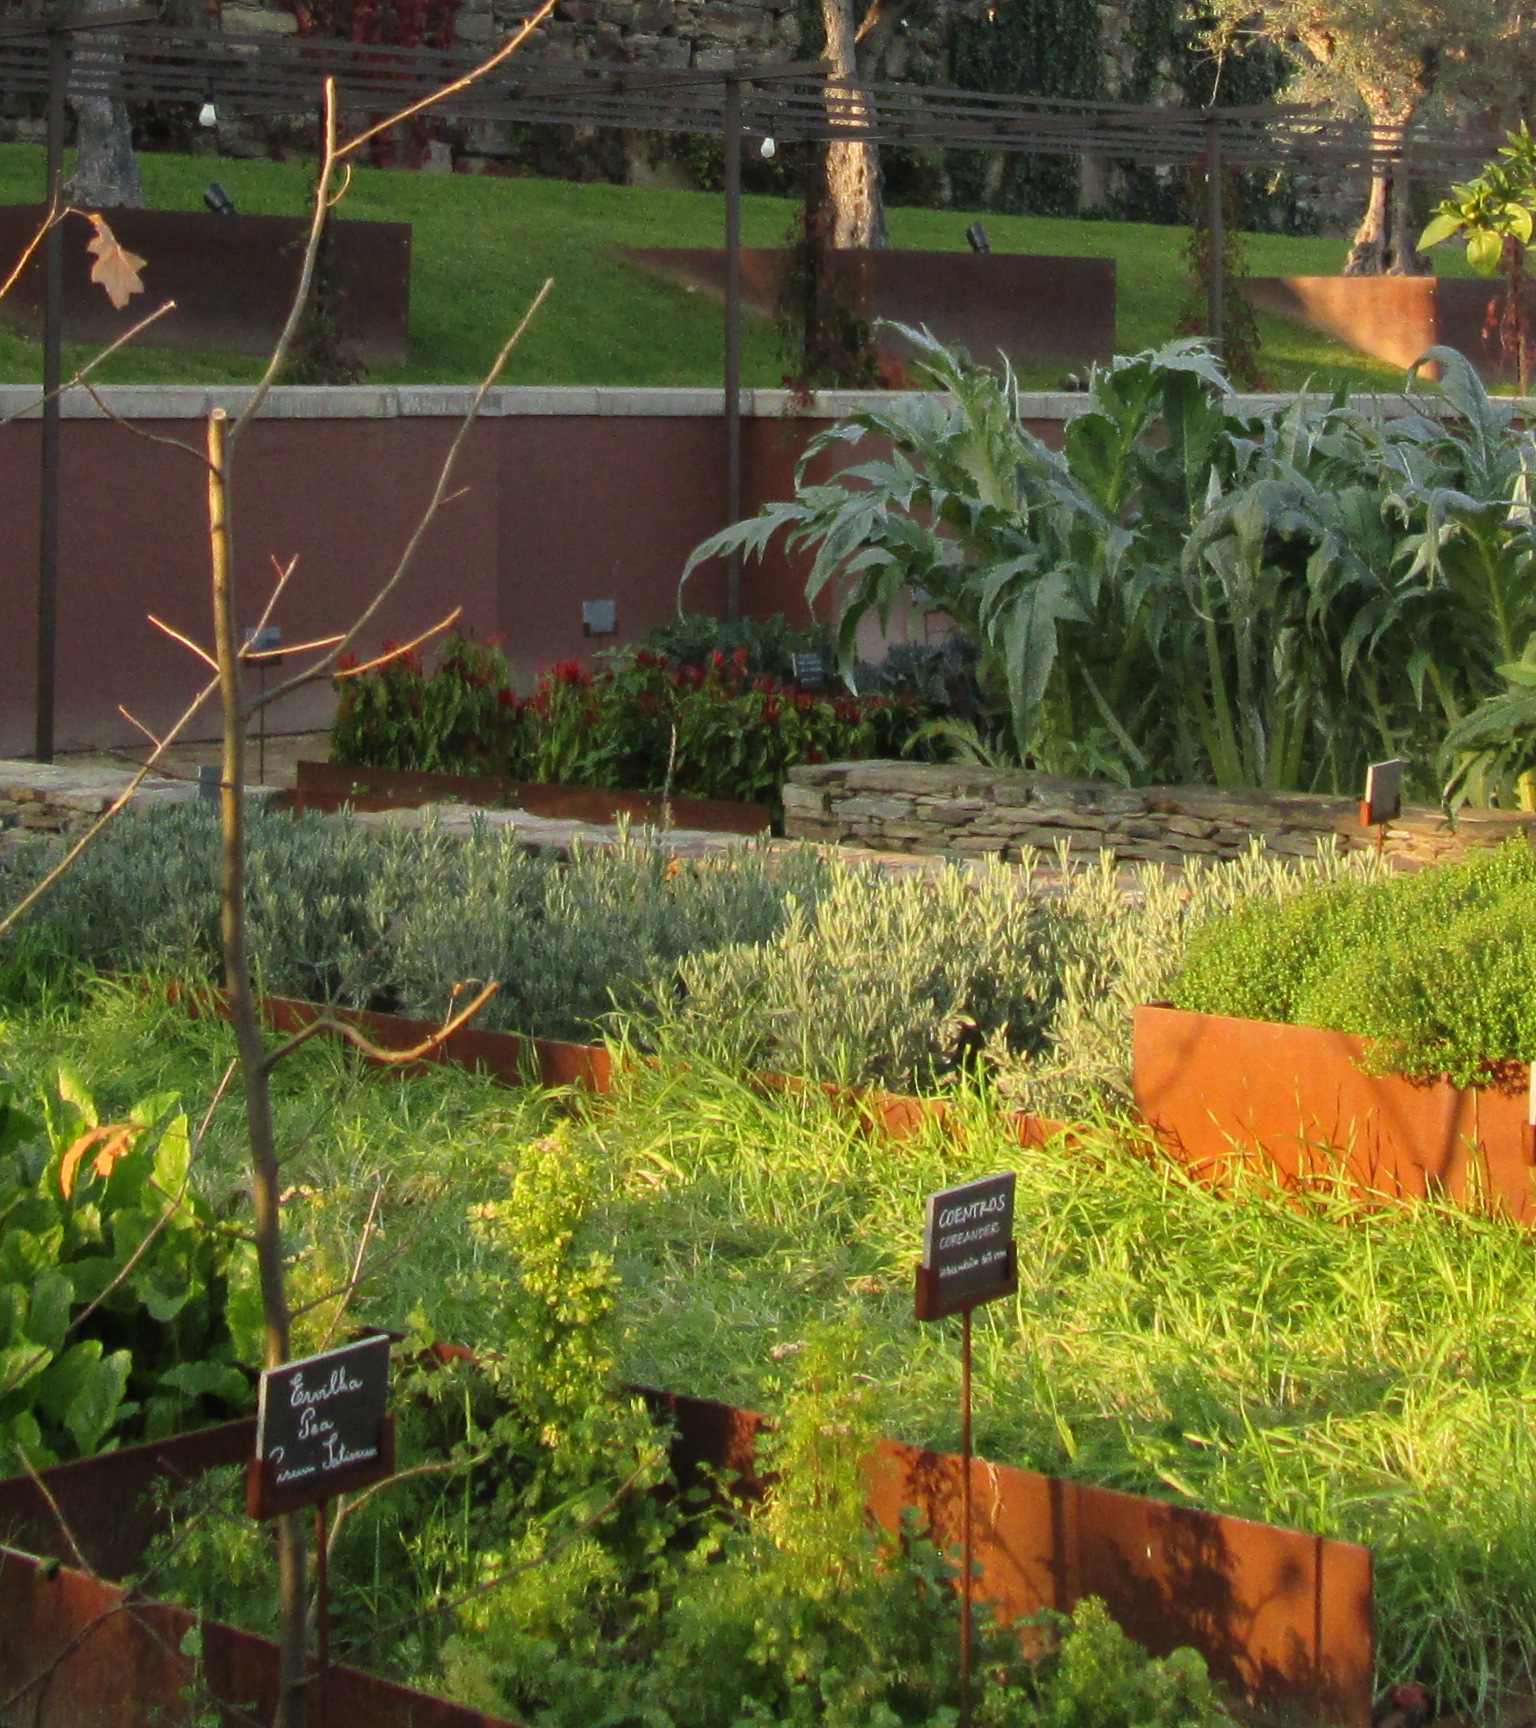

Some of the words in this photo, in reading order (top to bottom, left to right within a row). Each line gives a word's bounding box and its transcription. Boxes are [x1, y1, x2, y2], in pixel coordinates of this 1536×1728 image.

[939, 1195, 1005, 1228] COENTROS
[290, 1367, 363, 1407] Ervilha
[298, 1407, 334, 1439] Pea
